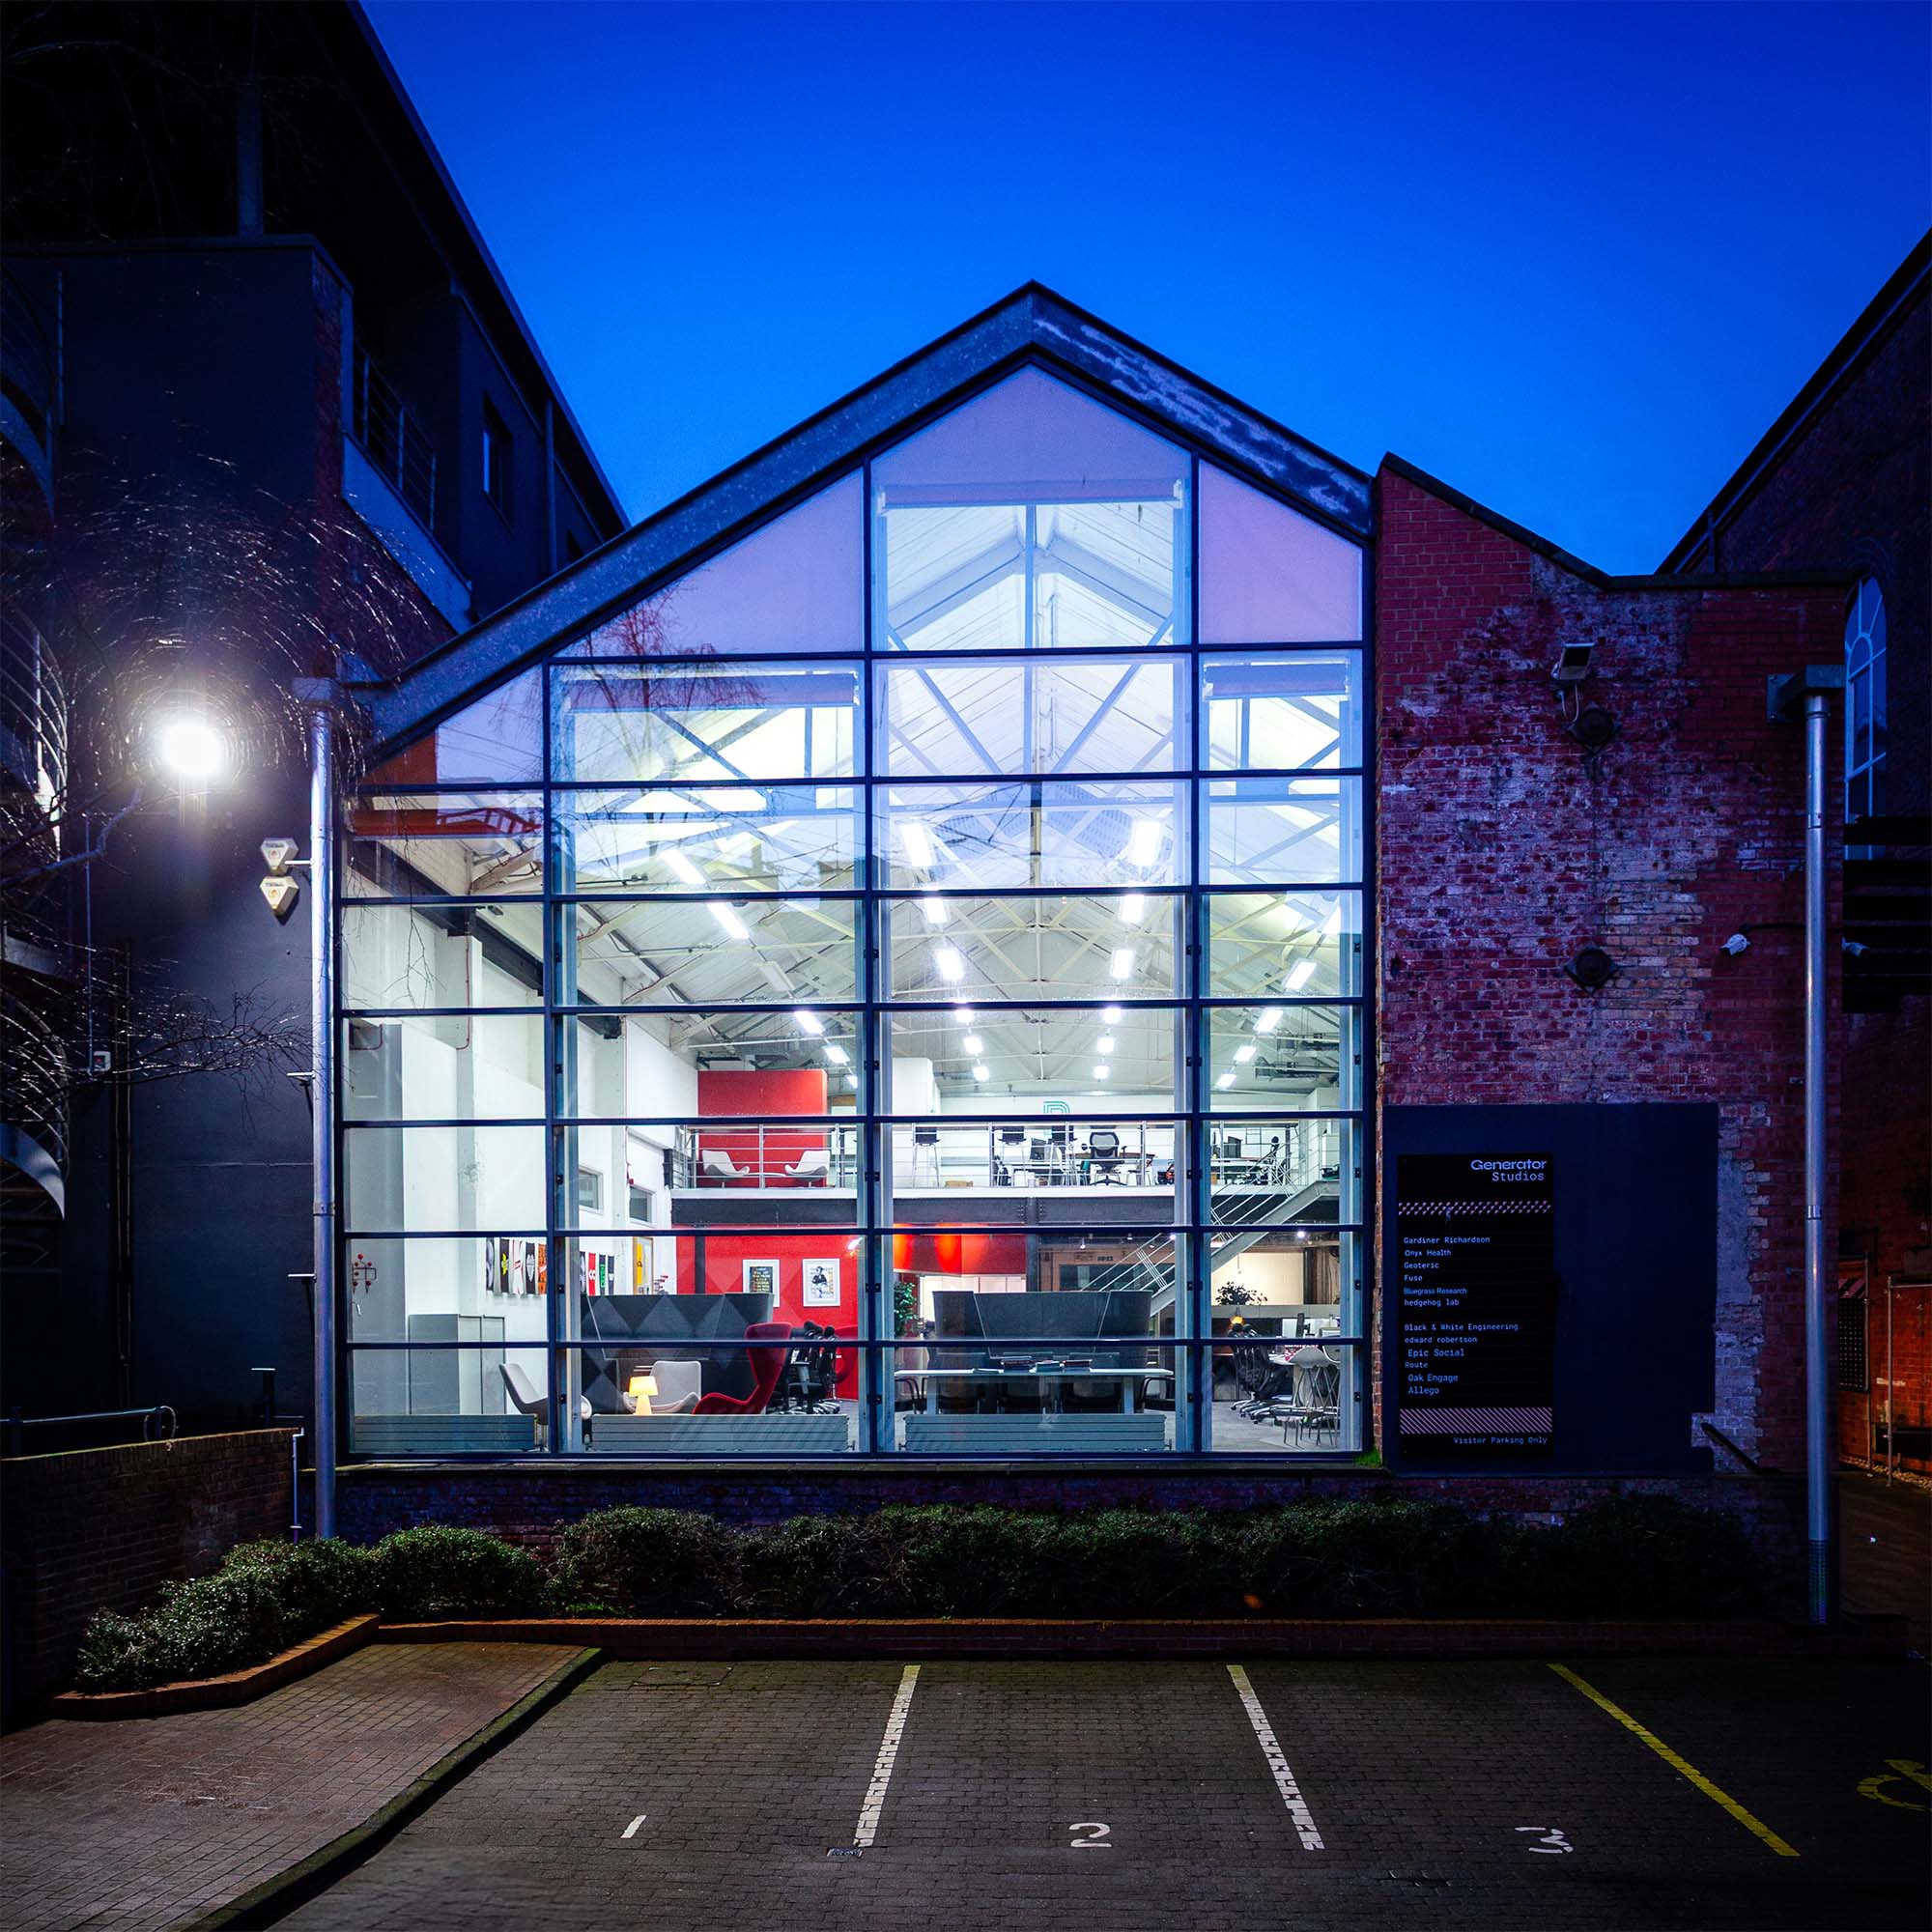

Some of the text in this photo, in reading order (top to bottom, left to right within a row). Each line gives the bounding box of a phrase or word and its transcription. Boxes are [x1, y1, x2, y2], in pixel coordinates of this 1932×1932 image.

[1470, 1159, 1548, 1170] Generator
[1492, 1172, 1545, 1181] Studios
[1404, 1248, 1452, 1258] Onyx Health
[1436, 1287, 1467, 1295] Research
[1404, 1298, 1441, 1307] hedgehog
[1407, 1349, 1464, 1358] Epic Social
[1407, 1374, 1459, 1383] Oak Engage
[1407, 1386, 1440, 1396] Allego
[1491, 1436, 1524, 1445] Parking
[1528, 1435, 1548, 1444] Only
[1068, 1823, 1112, 1848] 2
[1515, 1827, 1574, 1853] 3
